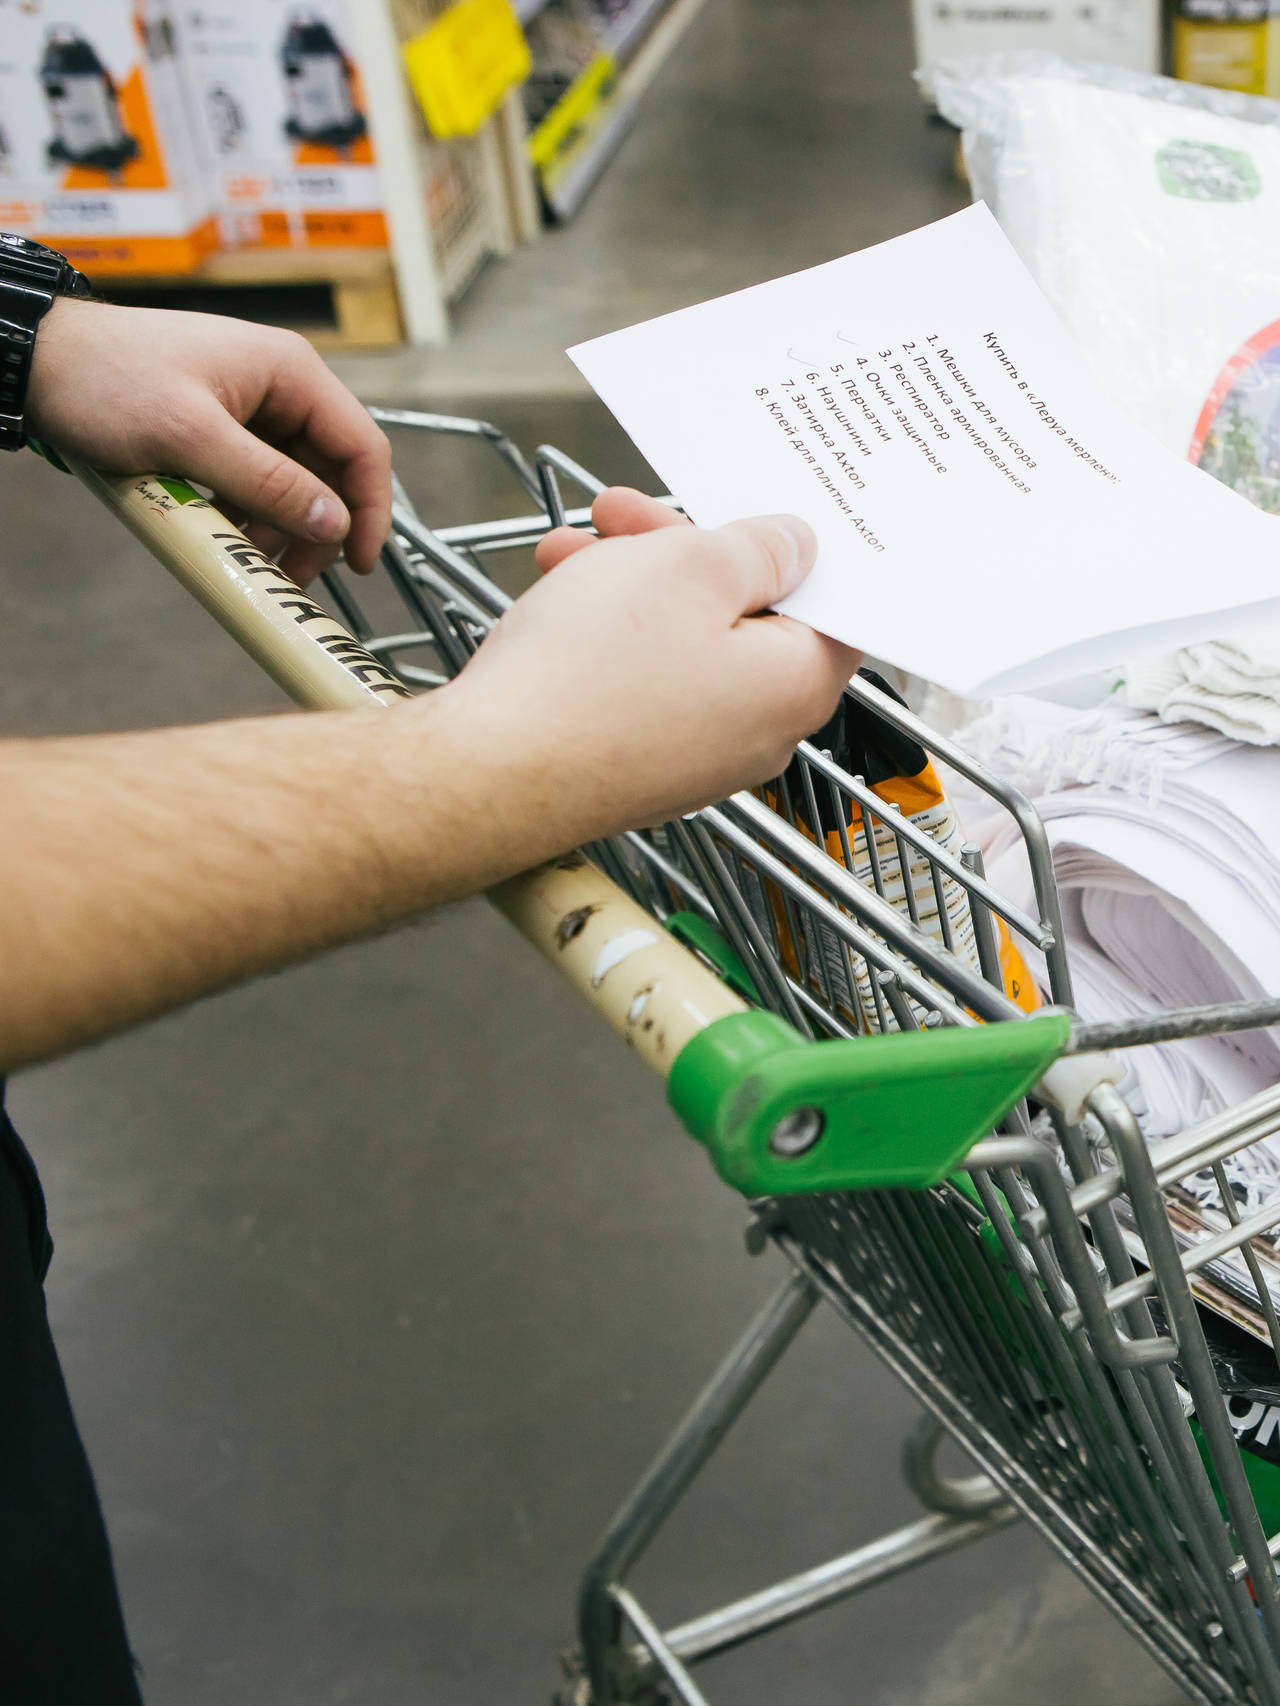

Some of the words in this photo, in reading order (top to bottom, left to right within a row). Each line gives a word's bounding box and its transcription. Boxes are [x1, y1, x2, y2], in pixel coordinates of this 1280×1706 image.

[780, 376, 796, 393] 7.
[790, 393, 836, 448] Затирка
[831, 451, 866, 490] Axton
[805, 372, 821, 385] 6.
[816, 385, 873, 457] Наушники
[829, 363, 845, 378] 5.
[840, 379, 893, 442] Перчатки
[855, 357, 869, 370] 4.
[865, 372, 896, 406] Очки
[891, 407, 948, 474] защитные
[877, 348, 893, 363] 3.
[888, 363, 951, 440] Респиратор
[901, 341, 917, 355] 2.
[912, 355, 954, 406] Пленка
[950, 407, 1032, 494] армированная
[925, 334, 940, 348] 1.
[936, 348, 977, 398] Мешки
[970, 401, 998, 424] для
[993, 426, 1037, 471] мусора
[982, 331, 1019, 380] Купить
[1016, 381, 1029, 392] в
[1026, 392, 1067, 436] «Леруа
[754, 387, 770, 401] 8.
[765, 401, 800, 436] Клей
[788, 439, 817, 464] для
[812, 465, 854, 515] плитки
[849, 518, 886, 553] Axton
